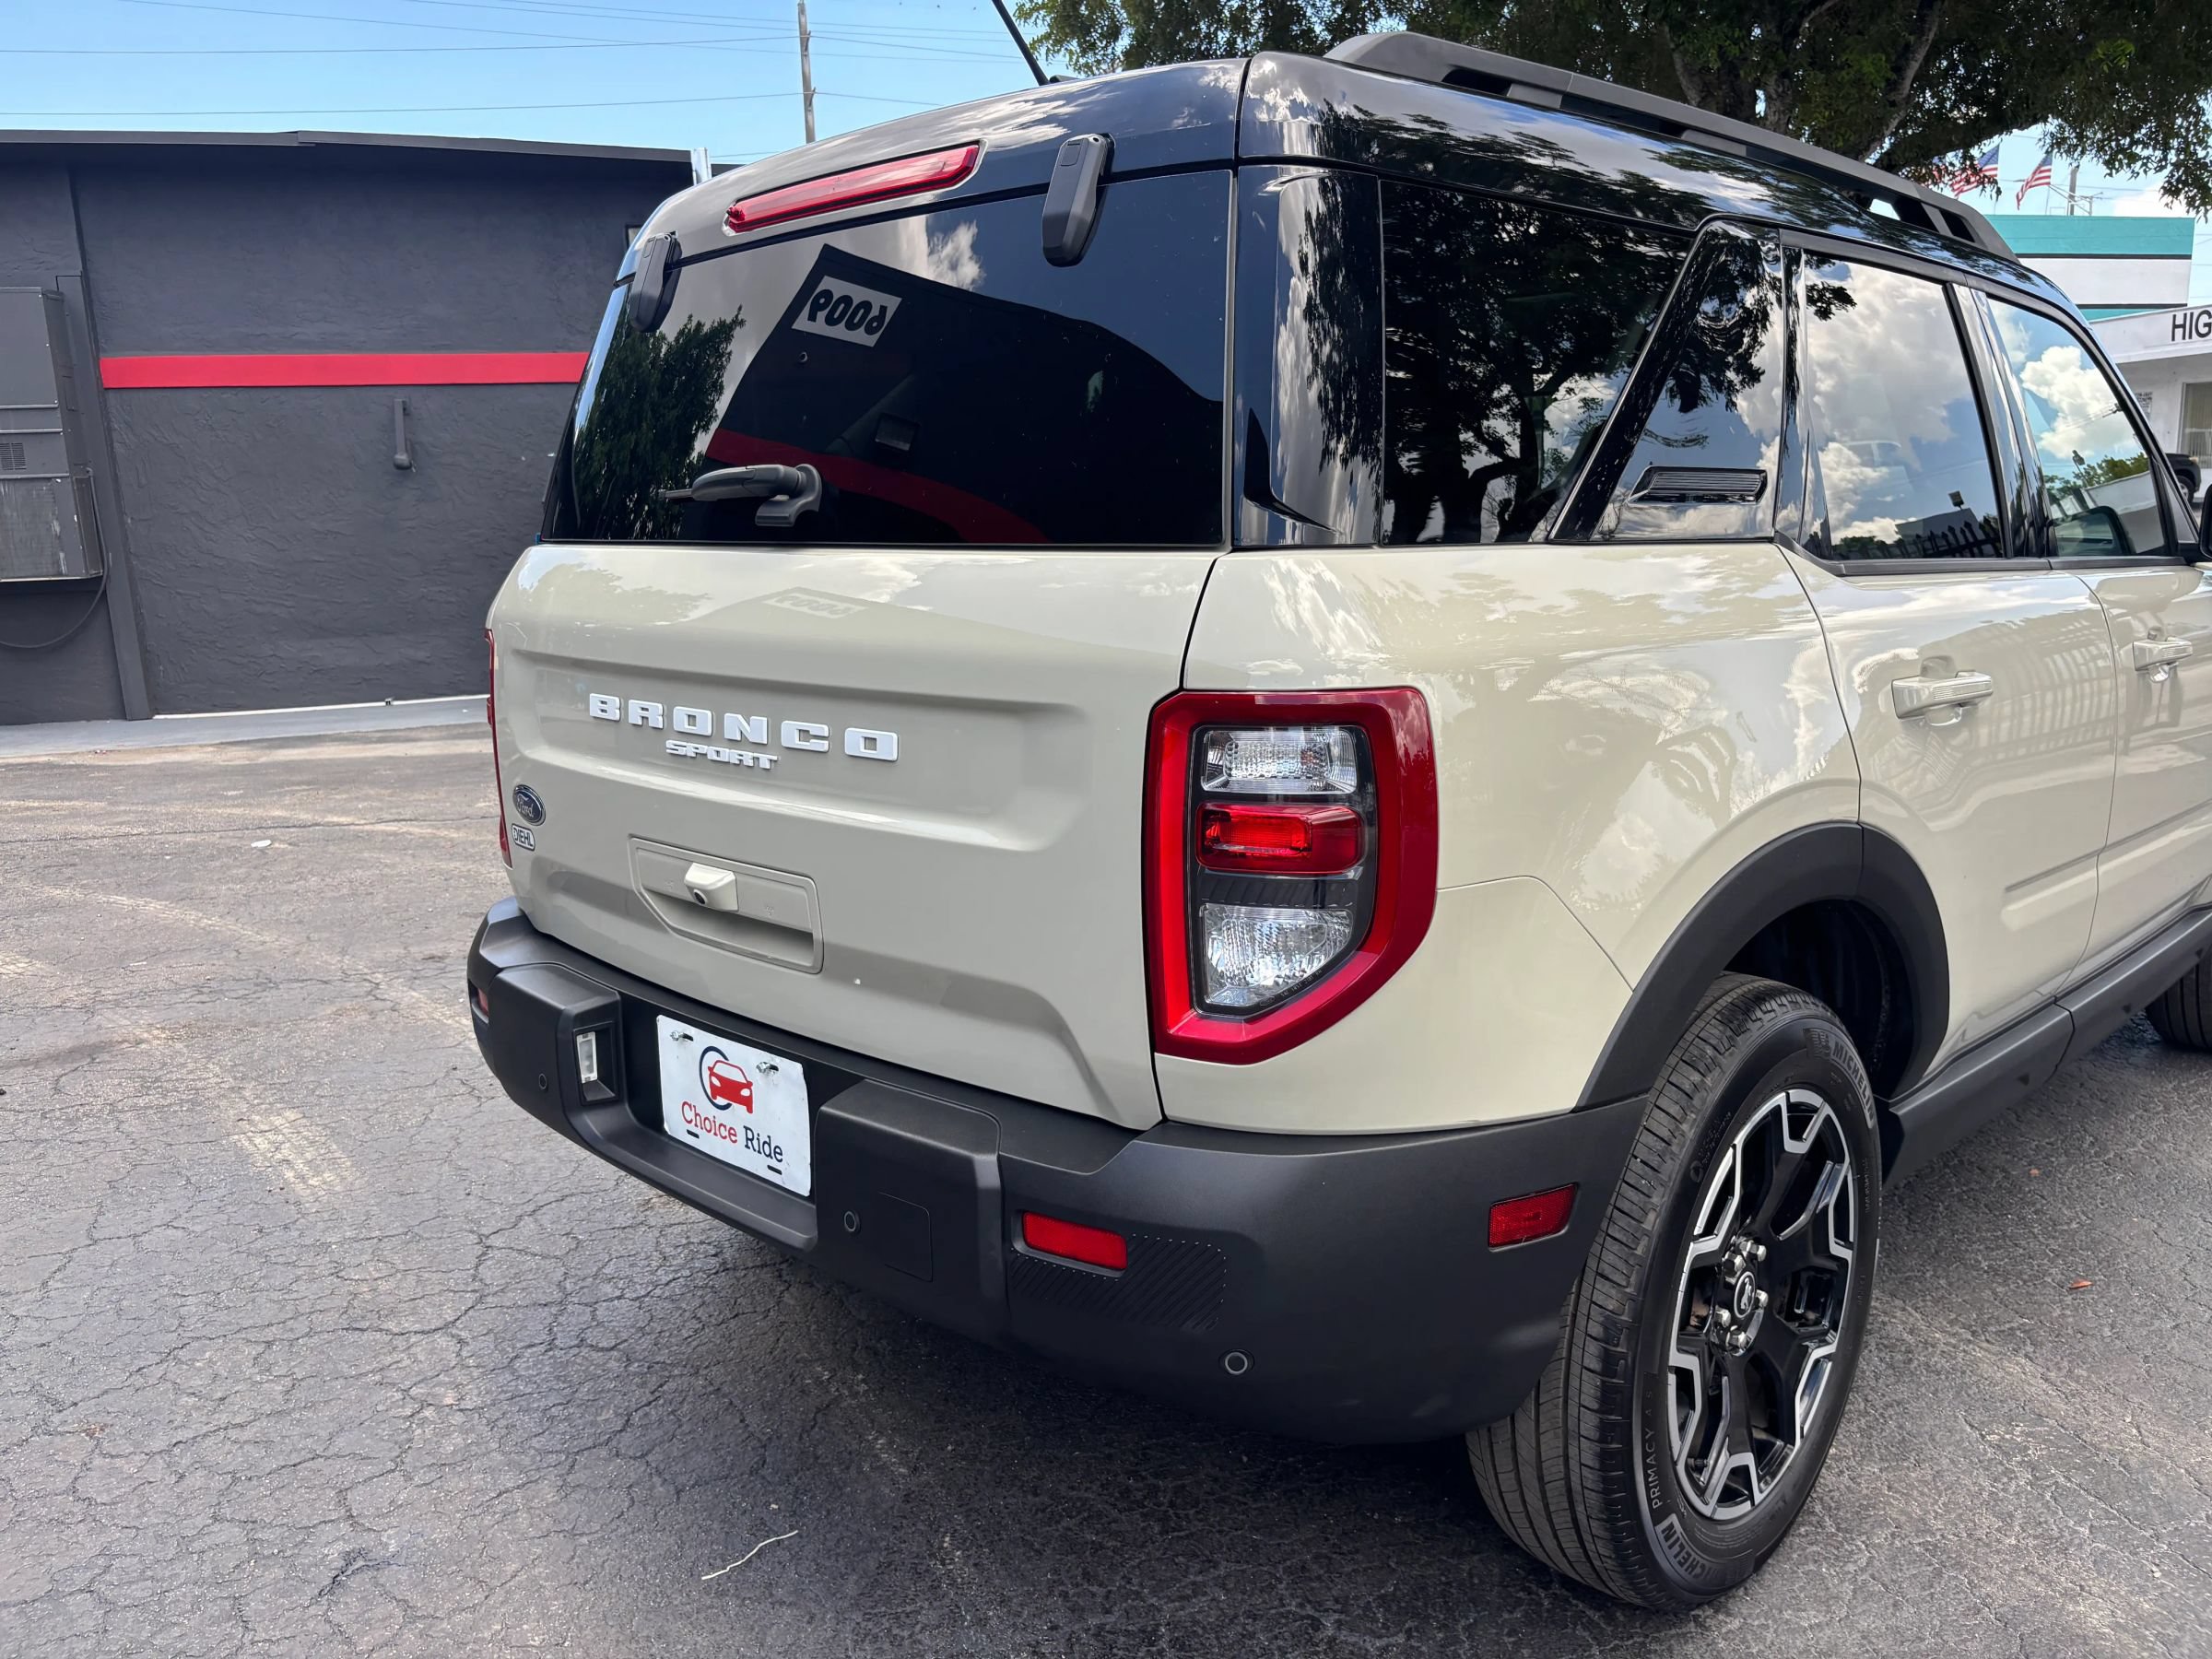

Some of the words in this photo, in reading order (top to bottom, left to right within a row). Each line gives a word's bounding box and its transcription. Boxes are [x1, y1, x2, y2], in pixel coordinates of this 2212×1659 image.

[2171, 310, 2212, 342] HIG
[589, 693, 899, 761] BRONCO
[665, 739, 778, 770] SPORT
[1832, 1041, 1874, 1122] MICHELIN
[681, 1100, 738, 1144] Choice
[743, 1125, 784, 1163] Ride
[1644, 1428, 1664, 1509] PRIMACY
